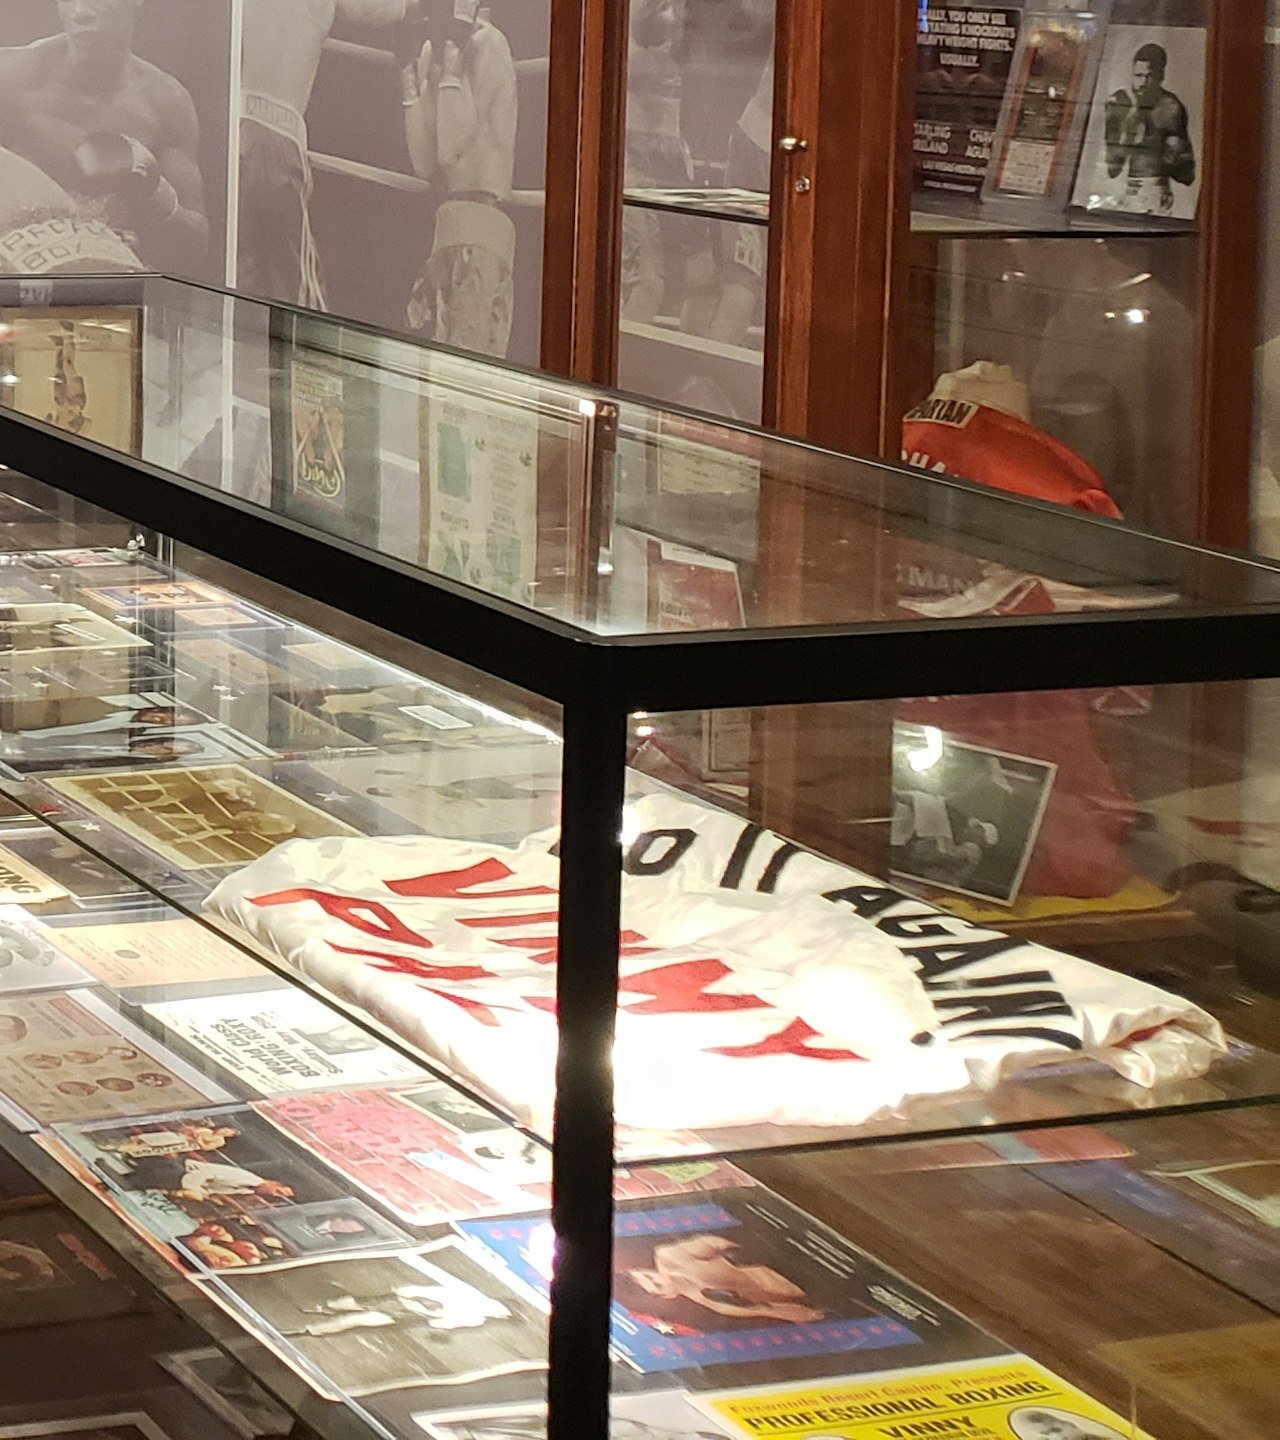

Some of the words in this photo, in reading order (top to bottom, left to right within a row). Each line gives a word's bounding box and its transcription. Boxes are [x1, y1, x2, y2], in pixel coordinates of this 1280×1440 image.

[962, 24, 1016, 39] KNOCKOUTS
[914, 123, 952, 139] TARLING
[210, 1023, 251, 1048] Class
[243, 1048, 293, 1076] World
[729, 1395, 821, 1415] Foxwoods
[822, 1388, 877, 1405] Resort
[882, 1381, 942, 1399] Casino
[950, 1370, 1028, 1389] Presents
[744, 1397, 947, 1432] PROFESSIONAL
[948, 1380, 1051, 1406] BOXING
[877, 1416, 977, 1440] VINNY
